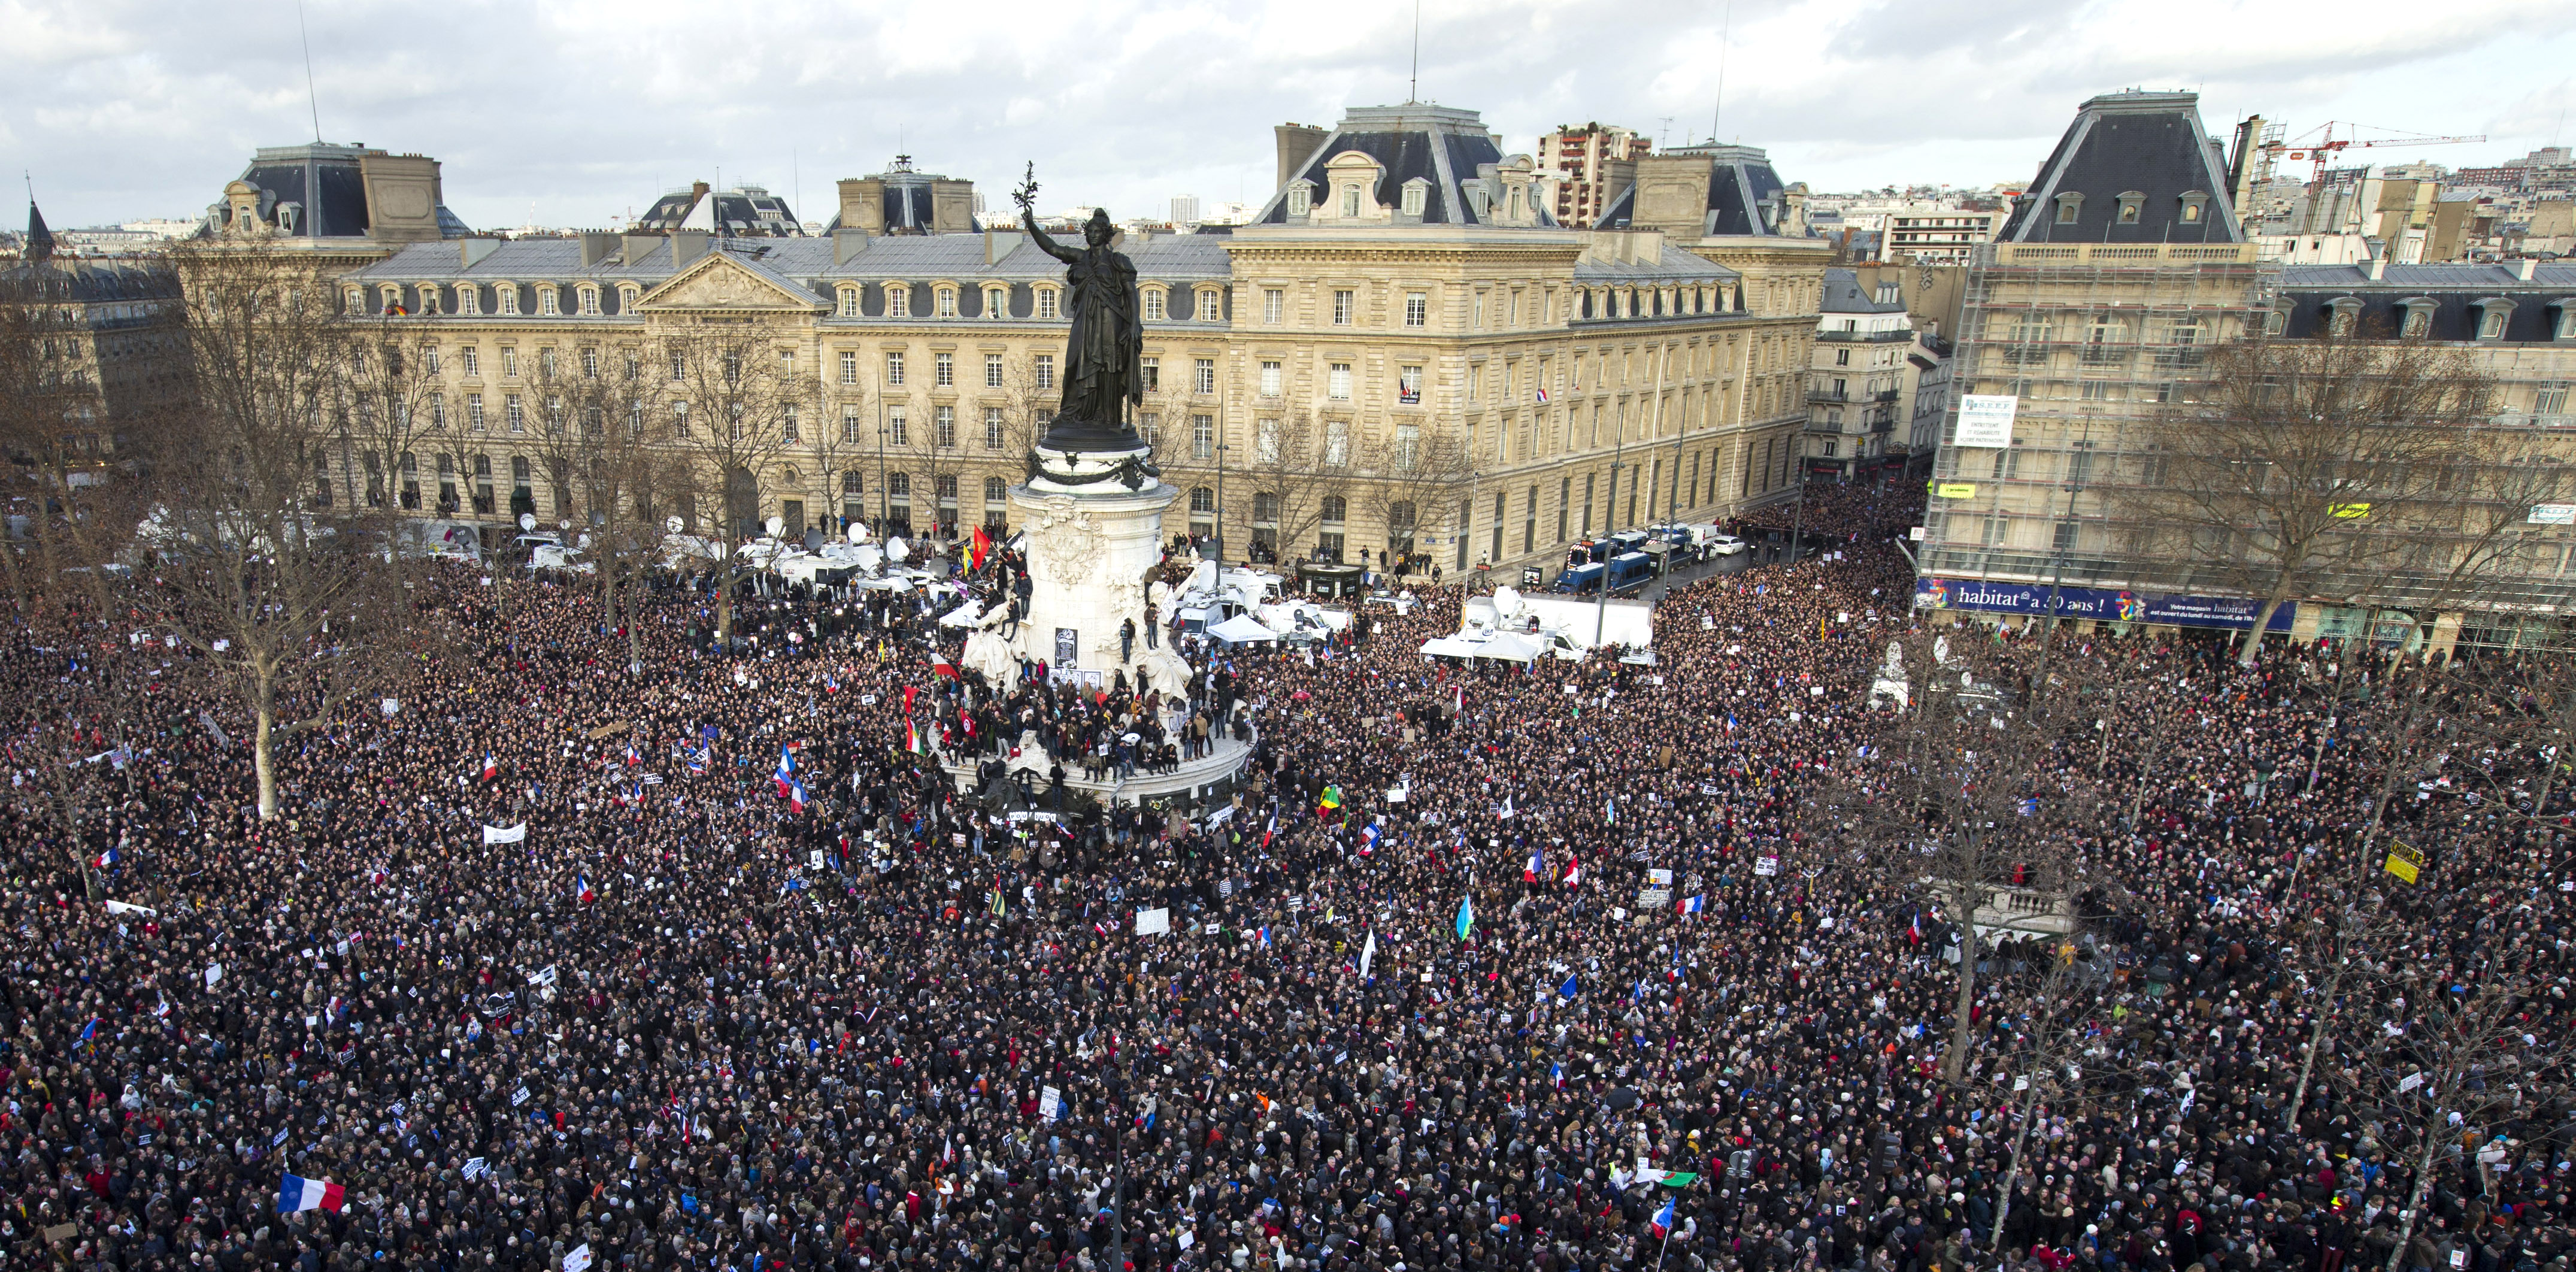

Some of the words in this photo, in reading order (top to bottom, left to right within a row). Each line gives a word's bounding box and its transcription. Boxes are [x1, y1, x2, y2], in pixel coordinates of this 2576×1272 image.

[1957, 587, 2020, 606] habitat
[2031, 598, 2039, 608] a
[2068, 598, 2094, 611] ans
[2213, 604, 2248, 614] habitat
[517, 1086, 528, 1096] SUIS
[513, 1090, 531, 1107] CHARLIE
[1042, 1094, 1058, 1102] CHARLIE
[278, 1127, 288, 1137] SUIS
[274, 1132, 289, 1146] CHARLIE
[572, 1255, 581, 1264] ALLE
